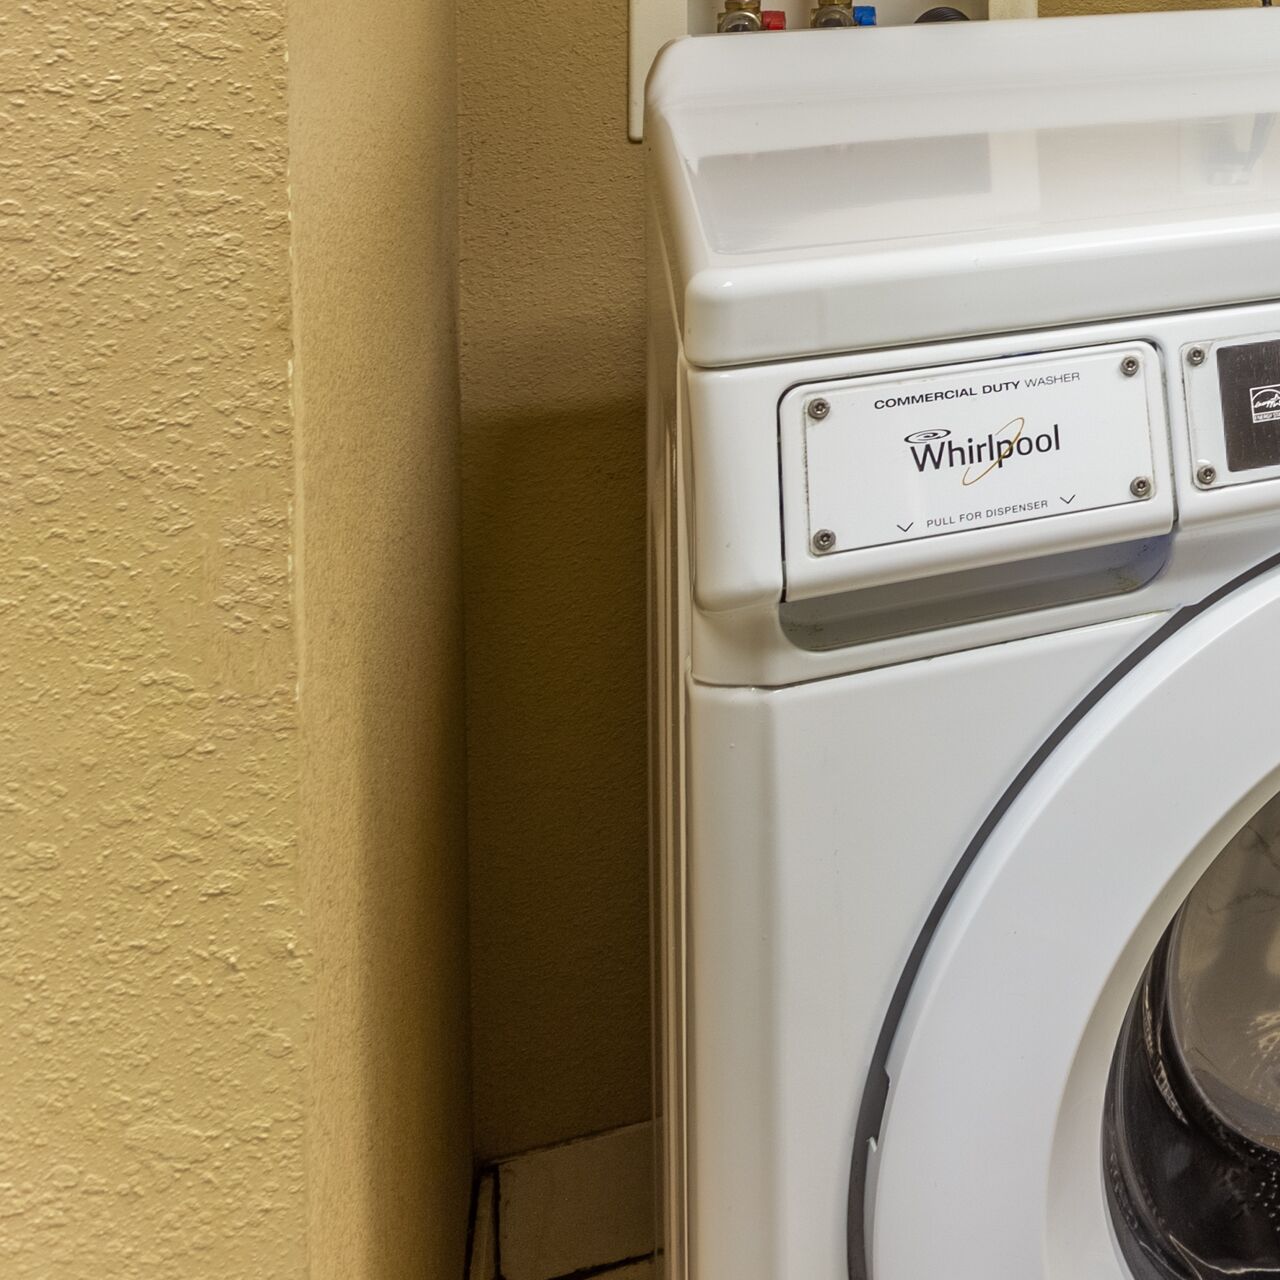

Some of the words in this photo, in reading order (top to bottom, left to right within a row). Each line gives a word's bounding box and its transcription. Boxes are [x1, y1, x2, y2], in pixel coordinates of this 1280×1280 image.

[874, 387, 978, 410] COMMERCIAL
[982, 380, 1021, 395] DUTY
[1024, 371, 1081, 388] WASHER
[909, 423, 1062, 473] Whirlpool
[926, 515, 957, 528] PULL
[959, 511, 982, 522] FOR
[985, 499, 1049, 518] DISPENSER
